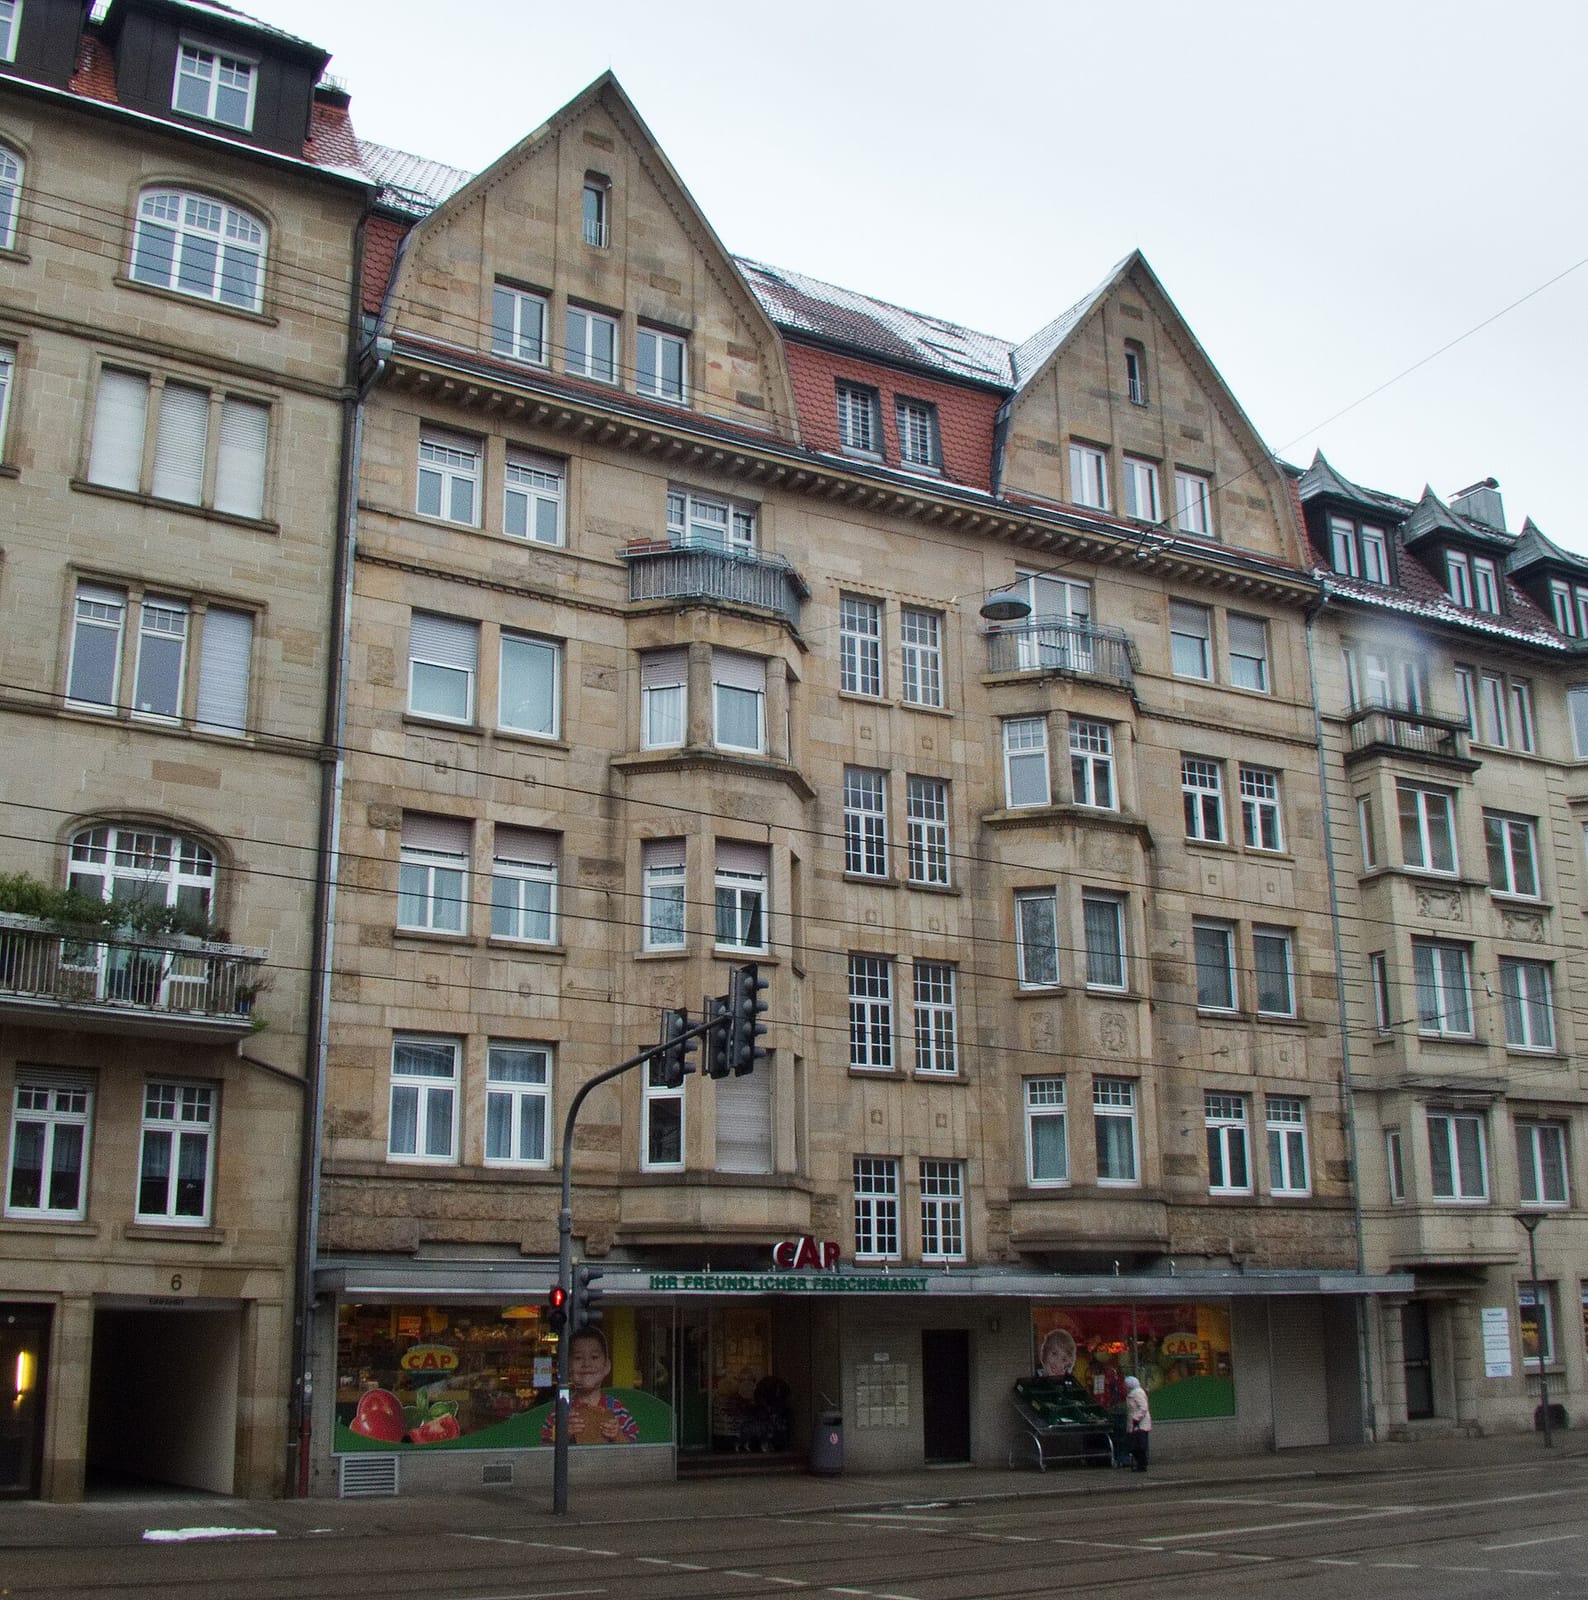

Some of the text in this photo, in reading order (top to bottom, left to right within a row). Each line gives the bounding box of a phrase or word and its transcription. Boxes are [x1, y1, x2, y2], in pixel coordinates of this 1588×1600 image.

[773, 1235, 840, 1269] CAP
[171, 1274, 182, 1291] 6
[650, 1275, 928, 1292] IHR FREUNDLICHER FRISCHEMARKT
[1167, 1341, 1197, 1354] CAP
[408, 1352, 452, 1369] CAP
